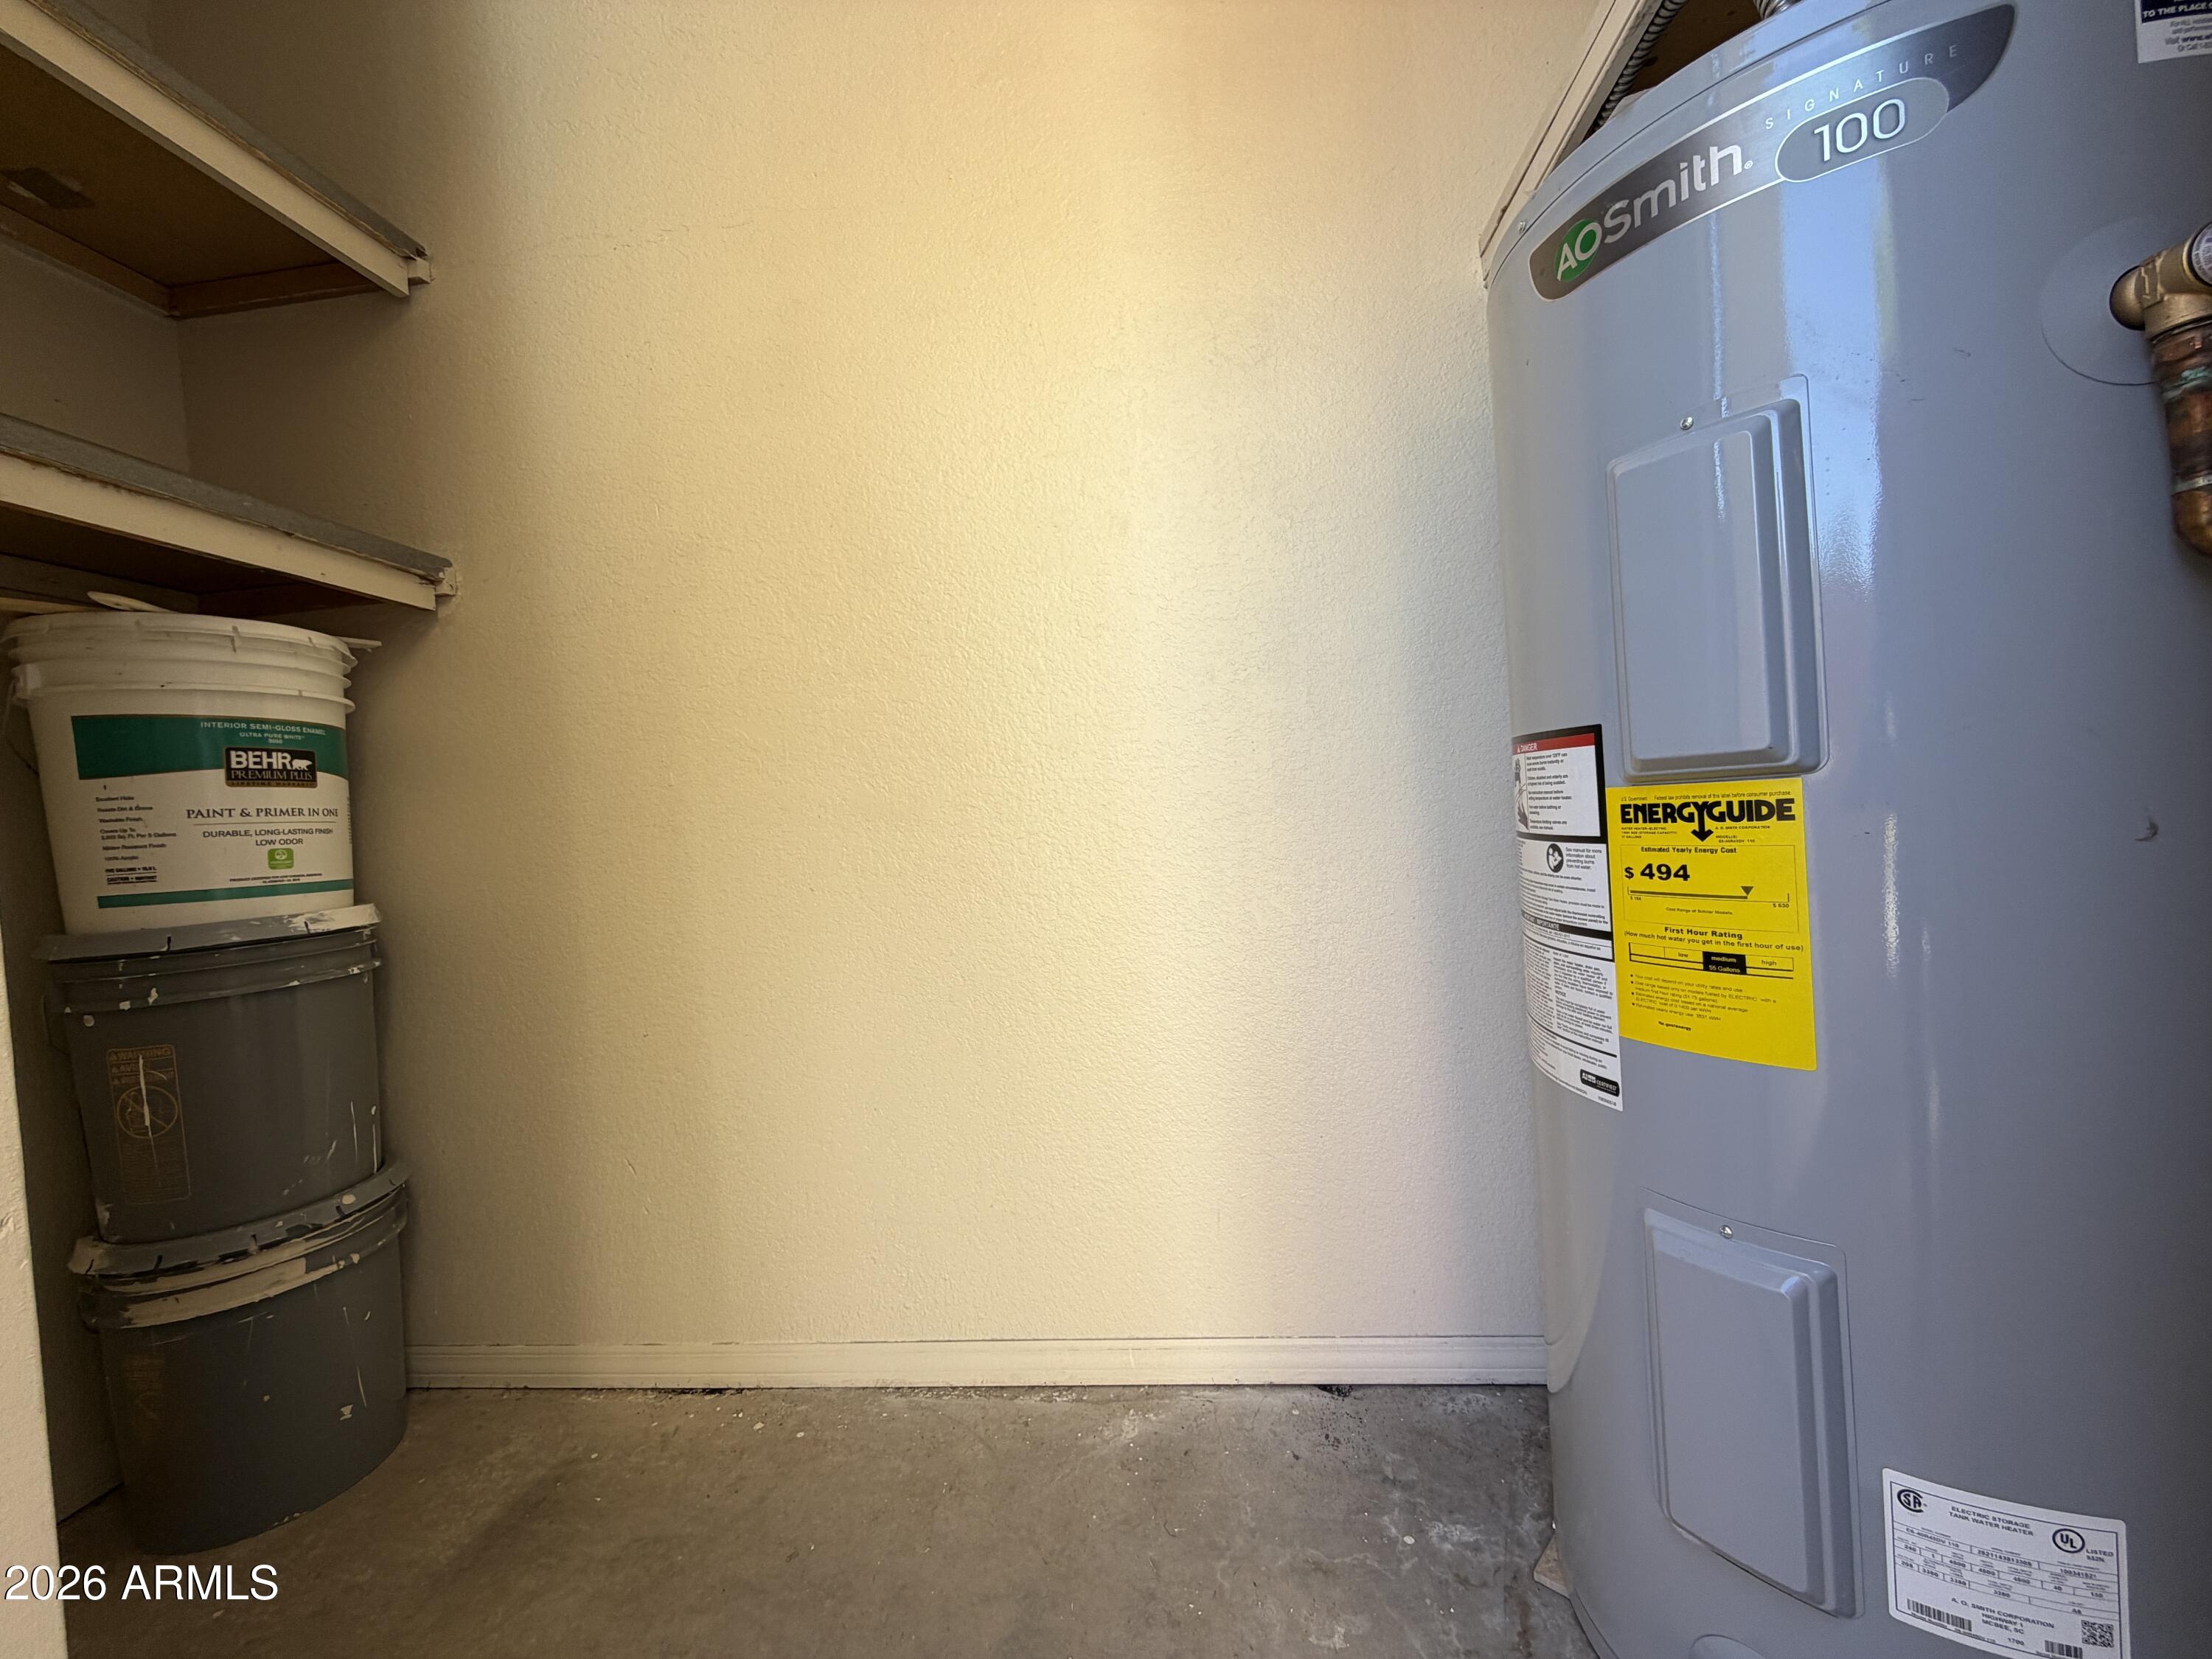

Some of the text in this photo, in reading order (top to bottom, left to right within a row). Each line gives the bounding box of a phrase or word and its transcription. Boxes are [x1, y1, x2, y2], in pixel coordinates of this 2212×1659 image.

[2143, 2, 2207, 18] TO THE PLACE
[1764, 44, 1958, 131] SIGNATURE
[1814, 97, 1906, 162] 100
[201, 721, 327, 736] INTERIOR SEMI-GLOSS ENAMEL
[1520, 742, 1538, 752] DANGER
[230, 750, 293, 770] BEHR
[231, 769, 313, 781] PREMIUM PLUS
[187, 807, 338, 819] PAINT & PRIMER IN ONE
[1620, 798, 1796, 826] ENERGYGUIDE
[203, 830, 253, 838] DURABLE,
[254, 828, 313, 836] LONG-LASTING
[279, 838, 304, 846] ODOR
[1672, 846, 1693, 855] Yearly
[1694, 846, 1718, 855] Energy
[1624, 863, 1691, 882] $ 494
[1664, 926, 1684, 934] First
[1711, 930, 1743, 940] Rating
[1711, 955, 1737, 963] medium
[1761, 959, 1778, 967] high
[1717, 965, 1741, 973] Gallons
[1728, 994, 1758, 1002] ELECTRIC
[1950, 1512, 2034, 1537] TANK WATER HEATER
[1951, 1506, 2031, 1529] ELECTRIC STORAGE
[2059, 1533, 2078, 1549] UL
[2086, 1548, 2115, 1557] LISTED
[1971, 1603, 1995, 1615] SMITH
[1997, 1610, 2055, 1629] CORPORATION
[1981, 1613, 2018, 1627] HIGHWAY
[1981, 1618, 2012, 1632] MCBEE,
